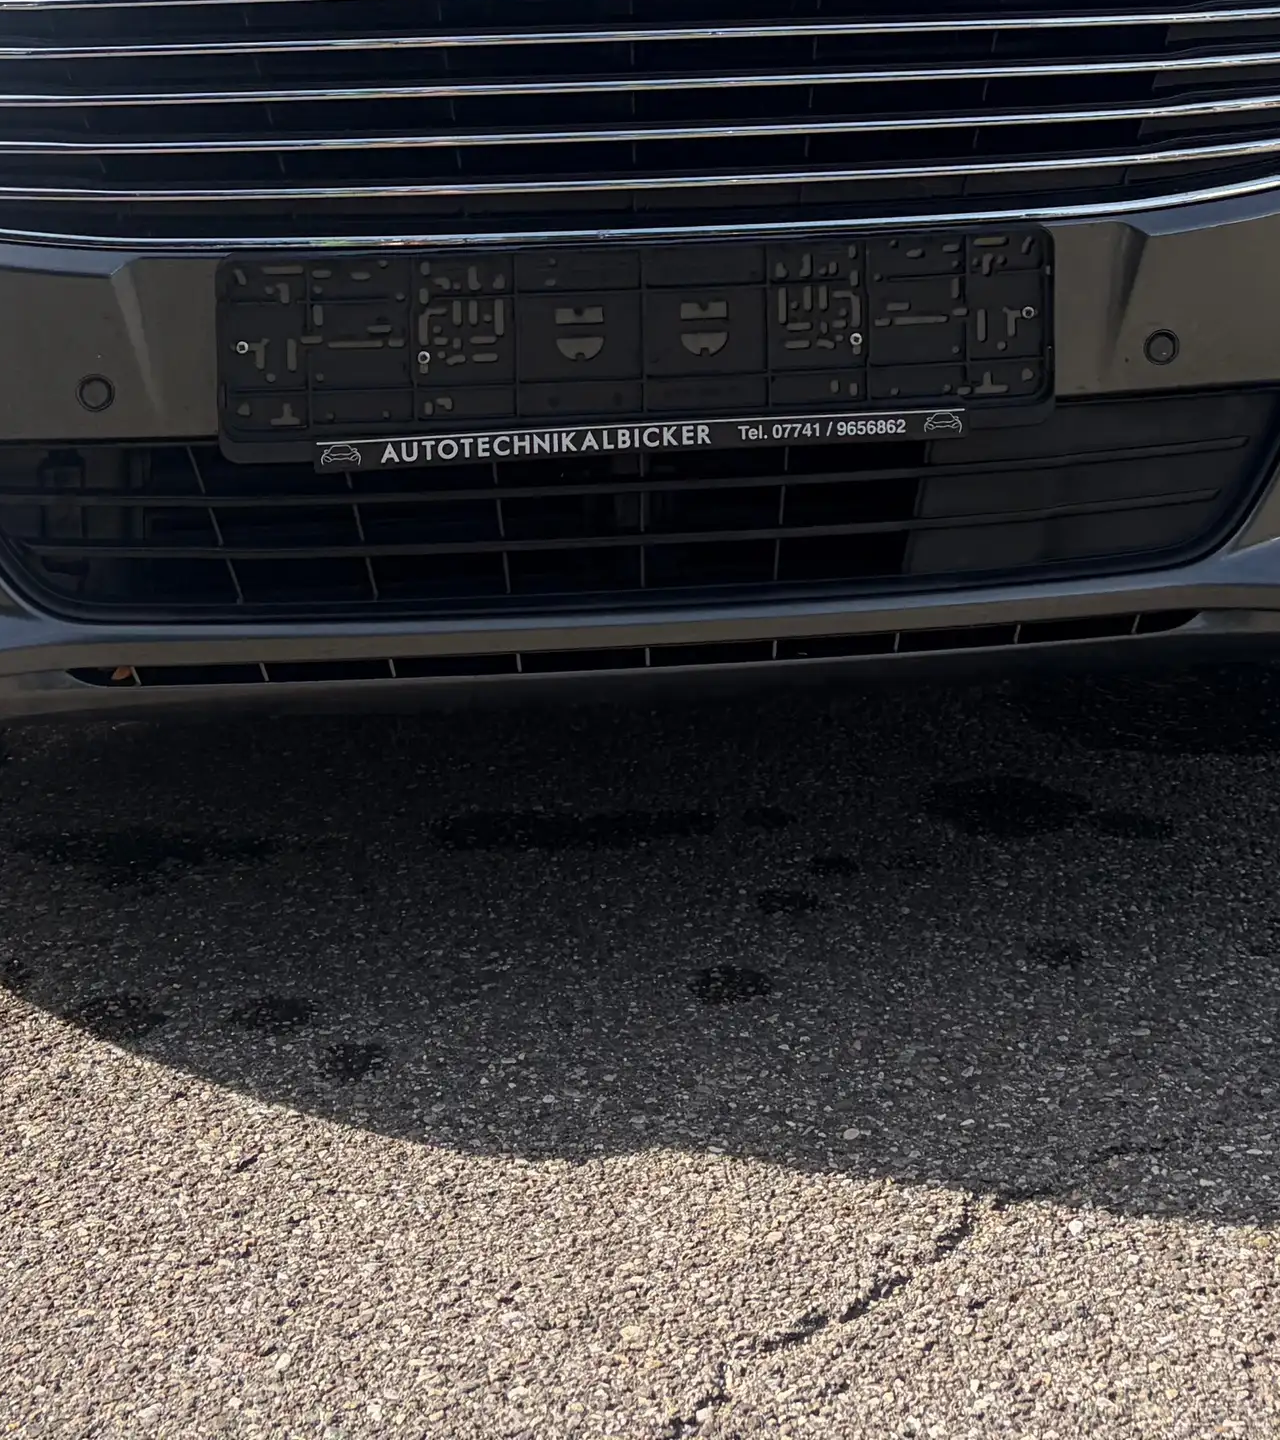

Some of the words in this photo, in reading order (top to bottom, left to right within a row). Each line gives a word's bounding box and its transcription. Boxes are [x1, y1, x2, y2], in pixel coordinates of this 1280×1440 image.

[737, 424, 768, 440] Tel.
[772, 422, 821, 439] 07741
[836, 418, 907, 437] 9656862
